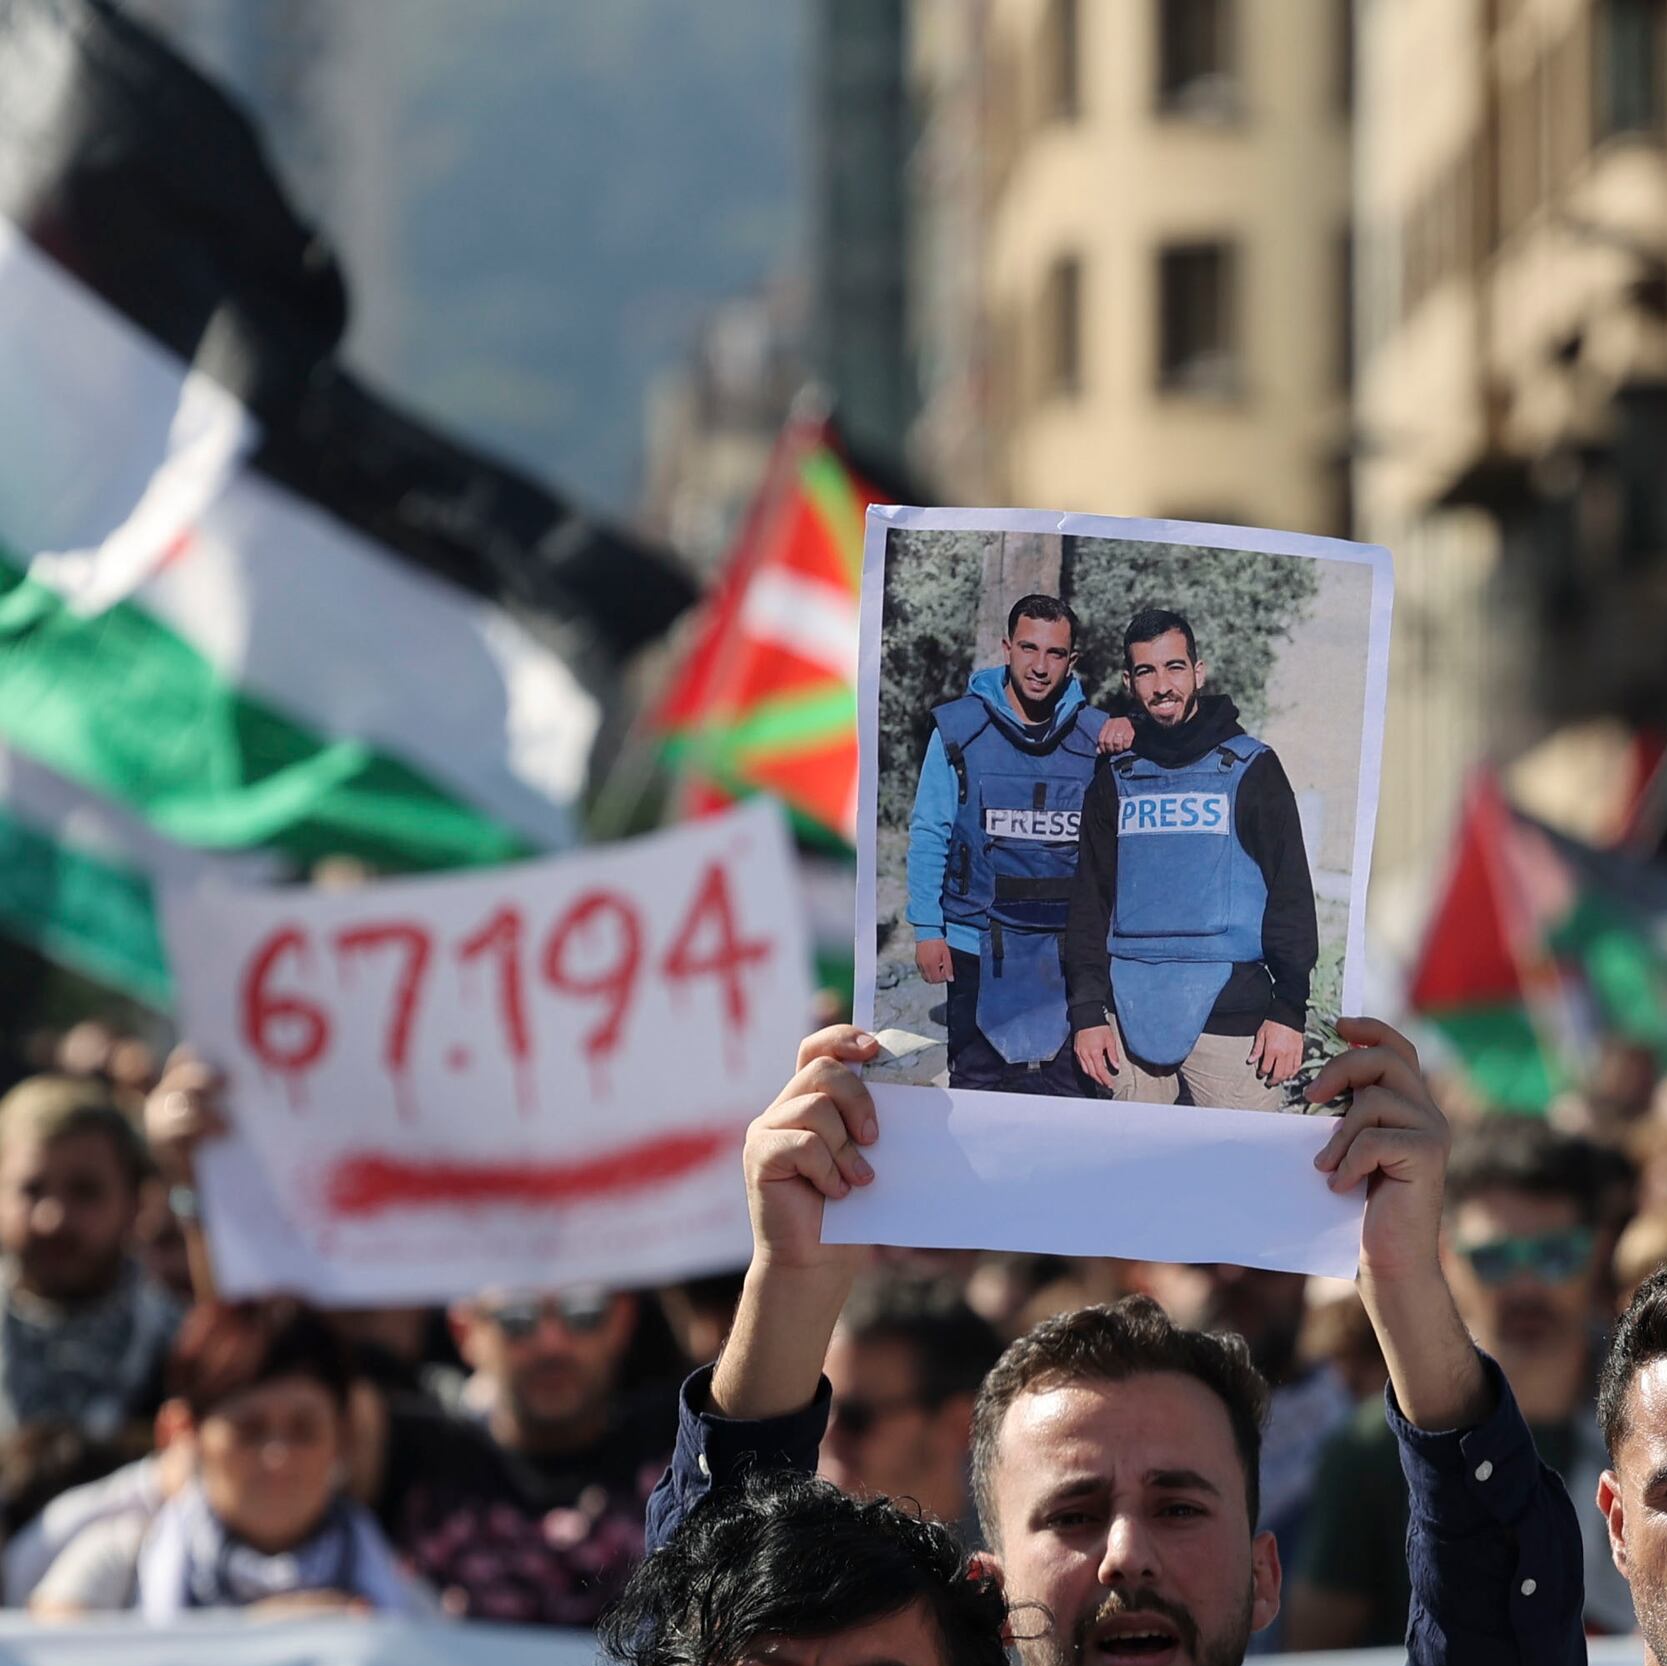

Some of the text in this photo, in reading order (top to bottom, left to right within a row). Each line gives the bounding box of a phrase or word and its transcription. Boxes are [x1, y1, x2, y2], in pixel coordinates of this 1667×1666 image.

[990, 810, 1081, 837] PRESS
[1121, 797, 1222, 831] PRESS
[239, 858, 775, 1080] 67.194
